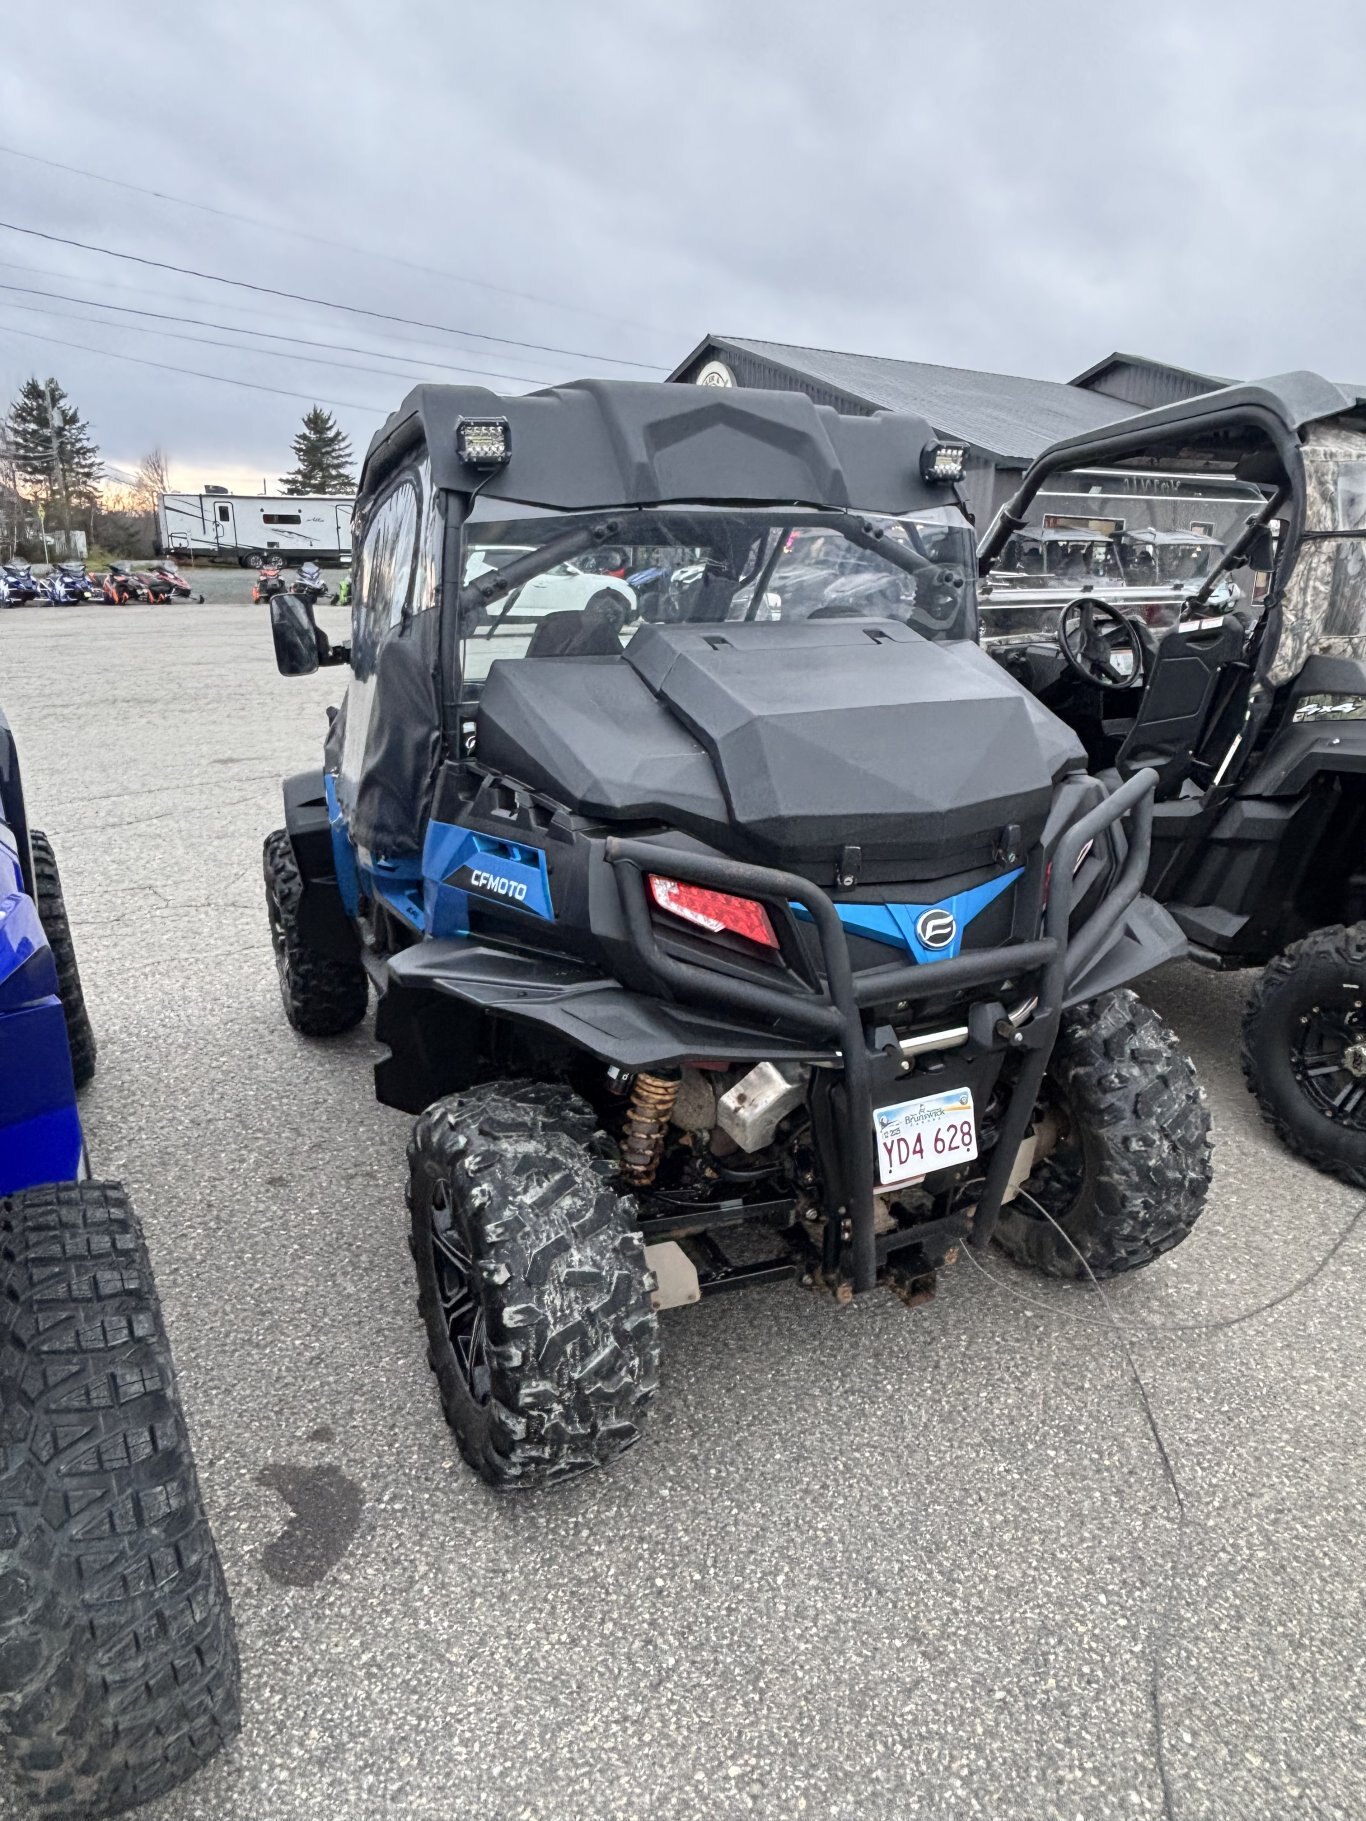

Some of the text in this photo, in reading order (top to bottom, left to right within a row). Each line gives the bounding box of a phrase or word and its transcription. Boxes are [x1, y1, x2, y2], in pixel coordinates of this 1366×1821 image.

[1296, 703, 1357, 715] 4x4
[471, 870, 527, 900] CFMOTO
[904, 1109, 945, 1125] Brunswick
[883, 1121, 973, 1168] YD4 628
